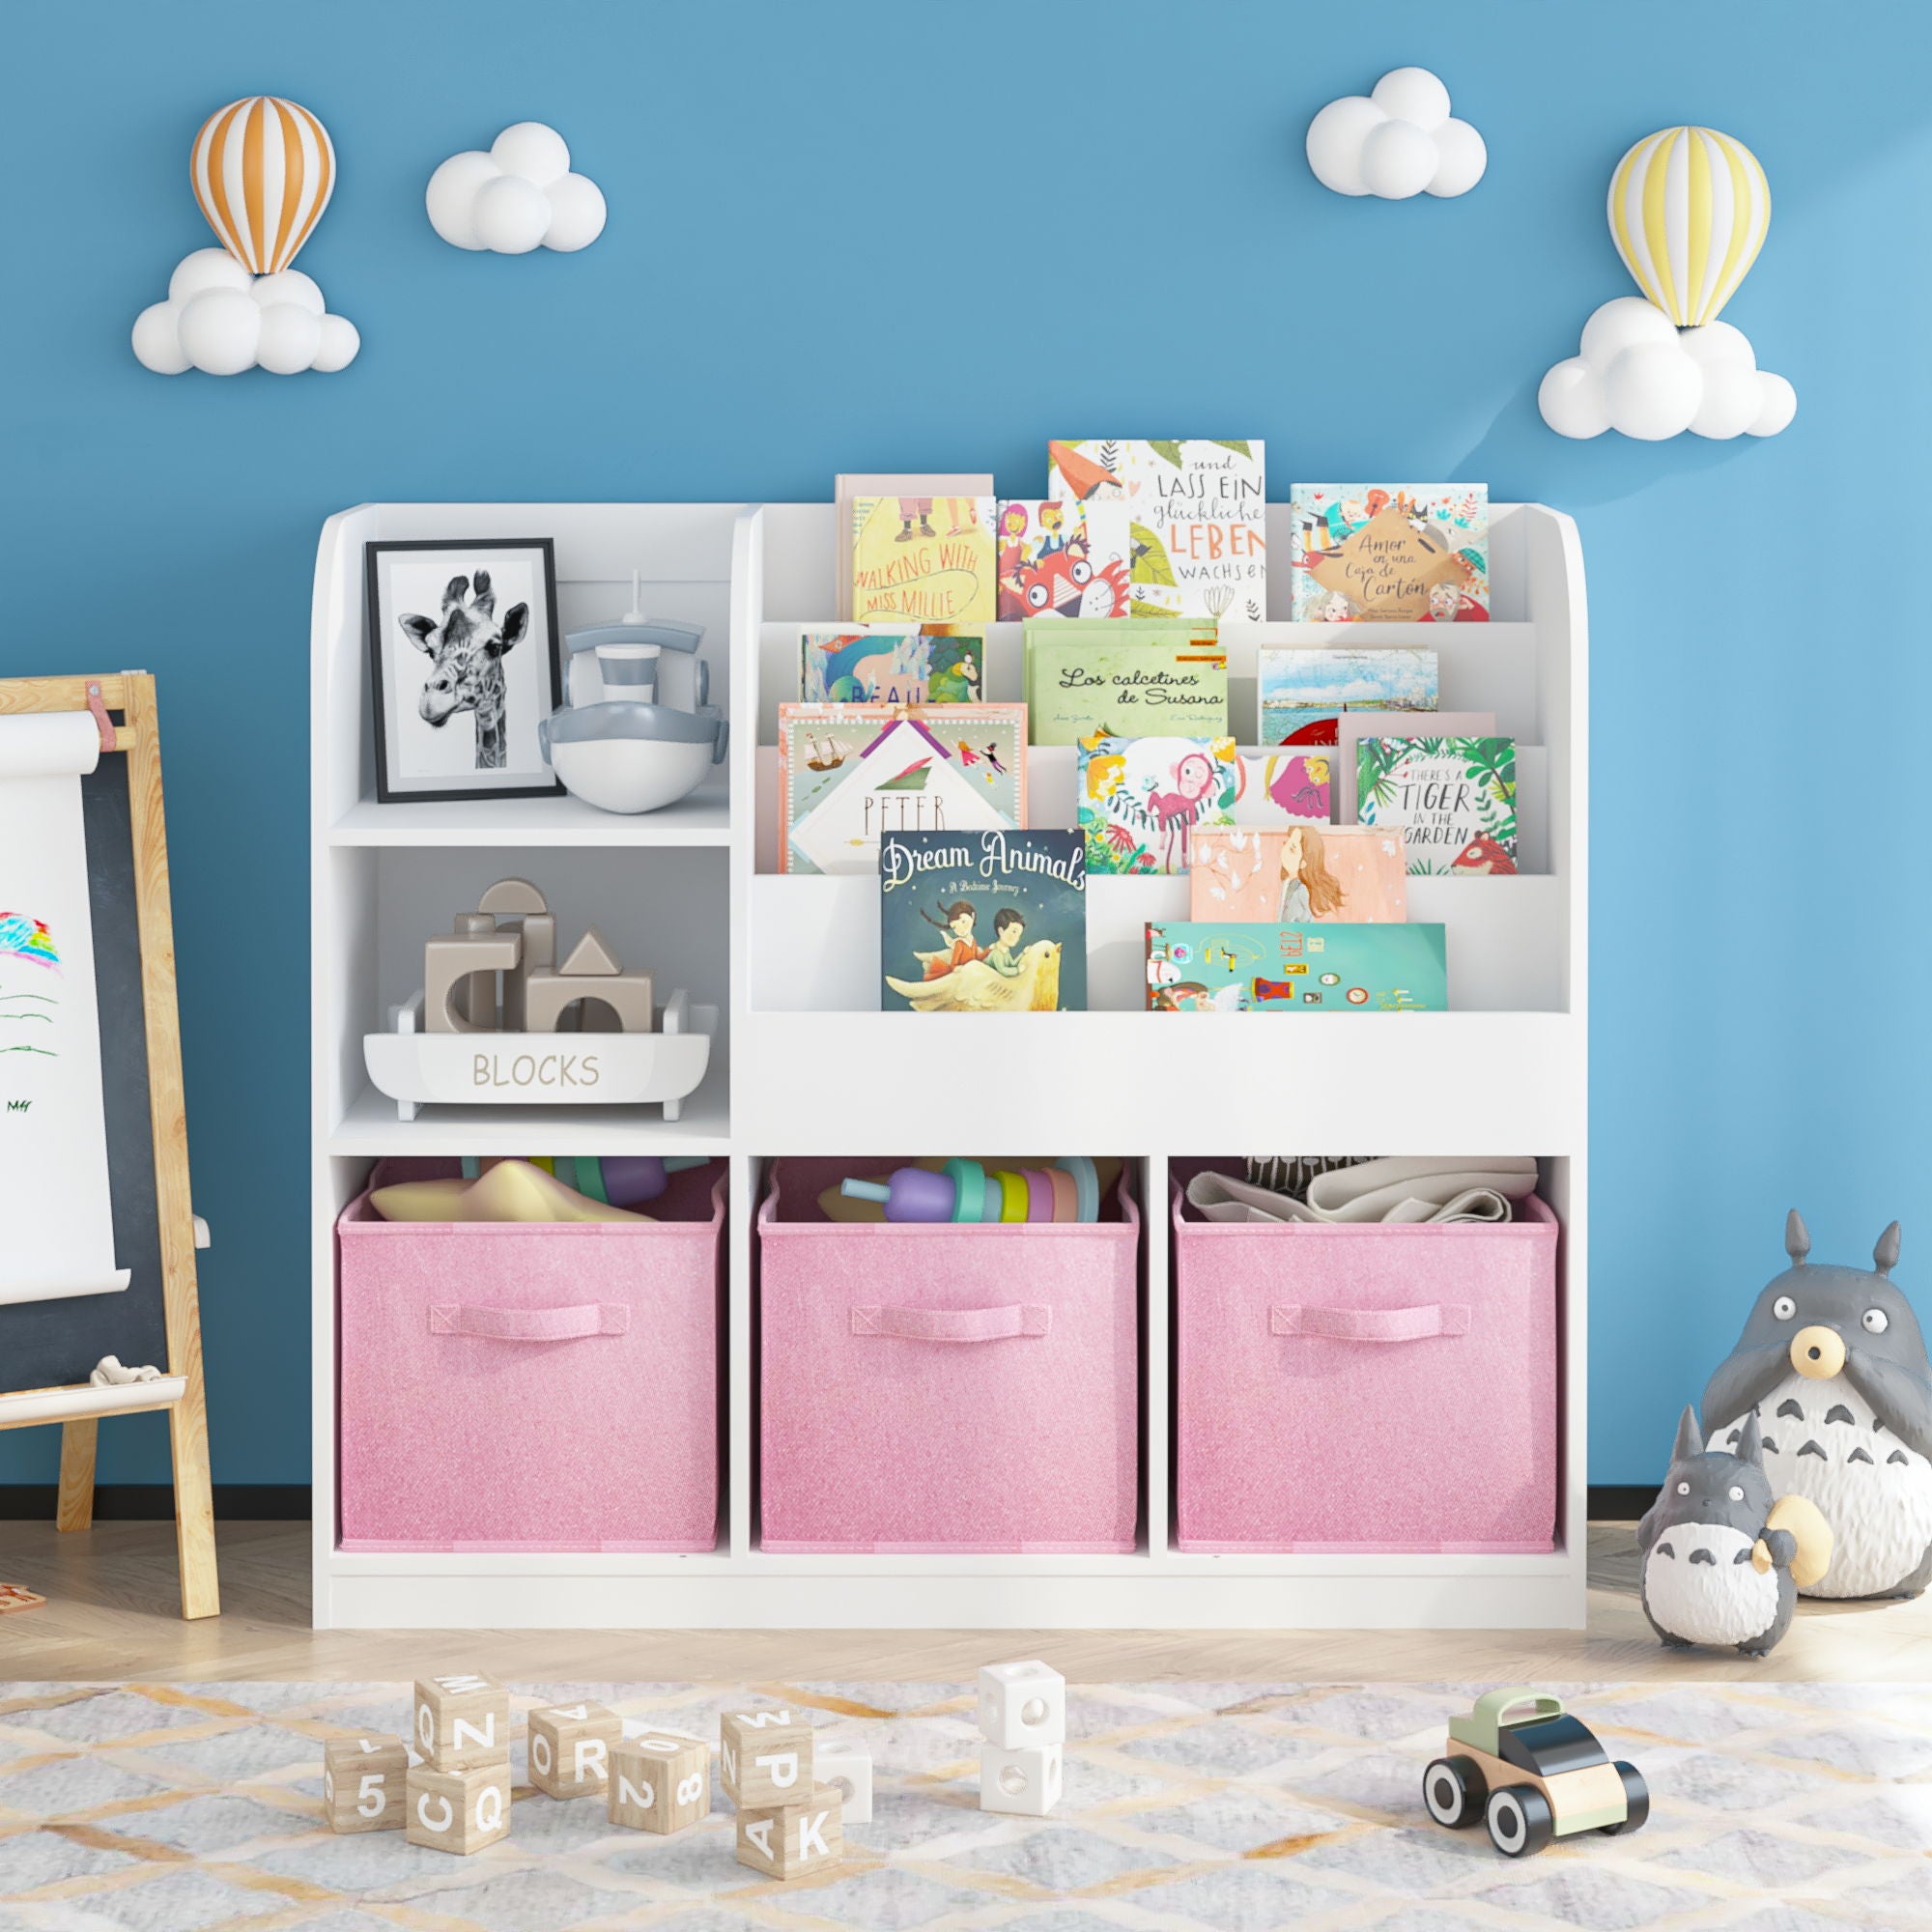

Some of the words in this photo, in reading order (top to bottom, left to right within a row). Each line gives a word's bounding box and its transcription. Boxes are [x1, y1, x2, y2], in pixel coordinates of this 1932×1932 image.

[1192, 454, 1237, 470] und
[1157, 473, 1205, 498] LASS
[1171, 524, 1266, 560] LEBEN
[1358, 533, 1406, 554] Amor
[856, 547, 931, 588] WALKING
[939, 542, 978, 573] WITH
[1346, 562, 1374, 583] Caja
[1379, 563, 1394, 577] de
[867, 591, 897, 611] MISS
[901, 589, 955, 618] MILLIE
[1363, 576, 1427, 602] Cartón
[1059, 668, 1105, 688] Los
[1112, 669, 1200, 686] calcetines
[1118, 689, 1140, 704] de
[1145, 688, 1224, 705] Susana
[1398, 781, 1471, 812] TIGER
[1413, 812, 1424, 825] IN
[1432, 812, 1454, 826] THE
[1405, 826, 1468, 845] GARDEN
[883, 838, 974, 893] Dream
[980, 830, 1086, 892] Animals
[472, 1053, 600, 1087] BLOCKS
[453, 1712, 496, 1751] N
[574, 1738, 610, 1784] R
[356, 1774, 387, 1818] 5
[676, 1772, 703, 1807] 8
[416, 1792, 454, 1833] C
[474, 1785, 503, 1833] Q
[799, 1809, 831, 1861] K
